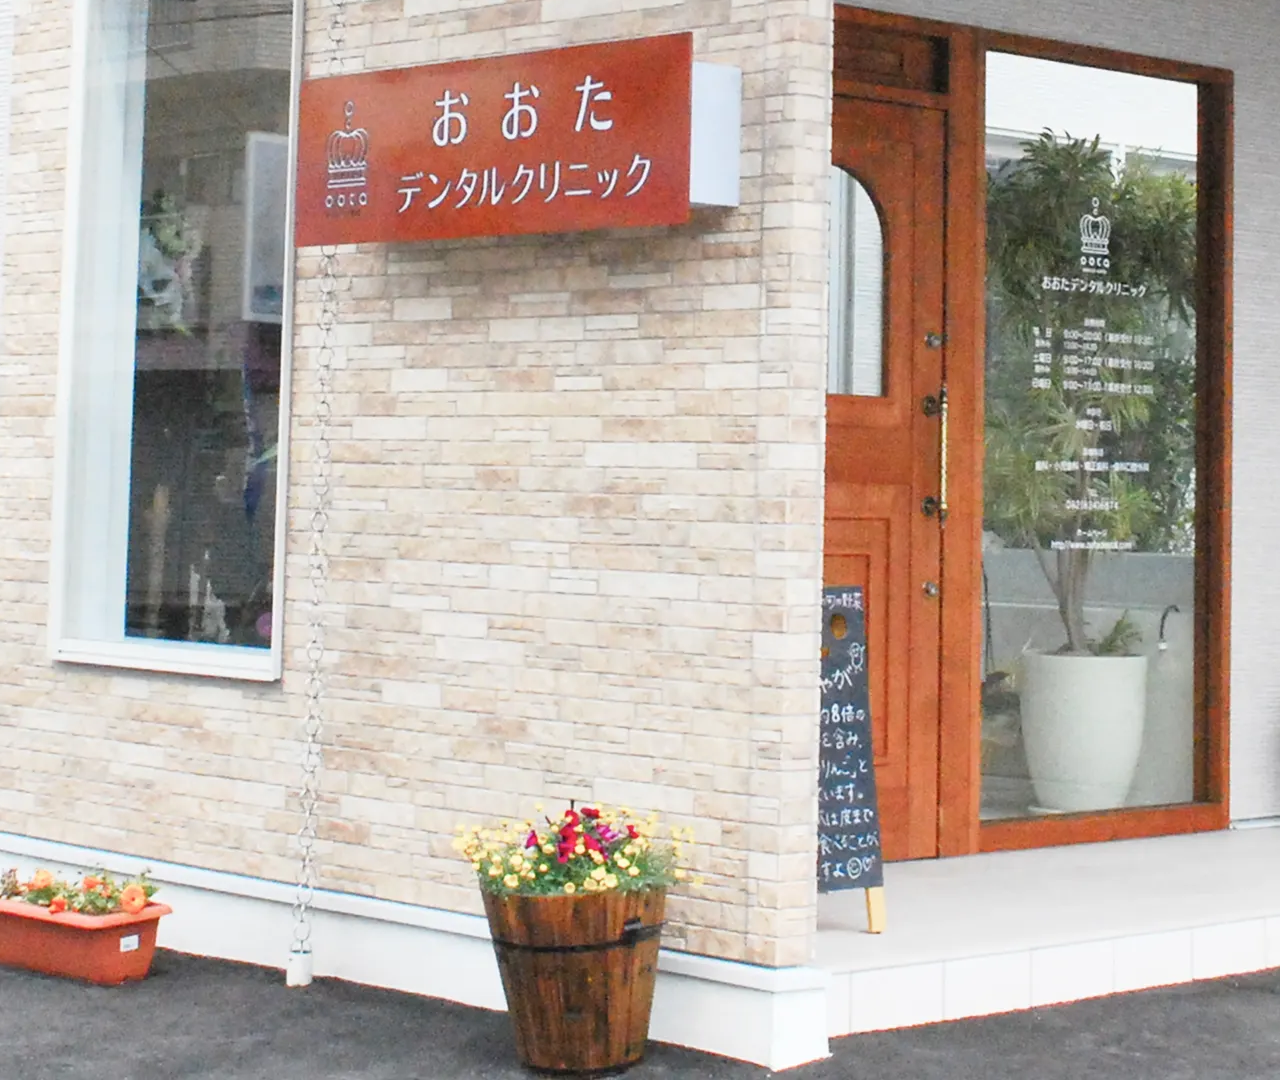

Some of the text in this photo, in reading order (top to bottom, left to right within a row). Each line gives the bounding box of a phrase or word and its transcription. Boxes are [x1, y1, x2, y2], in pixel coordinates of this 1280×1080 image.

[432, 74, 614, 148] おおた
[396, 152, 652, 213] デンタルクリニック
[1041, 275, 1147, 297] おおたデンタルクリニック
